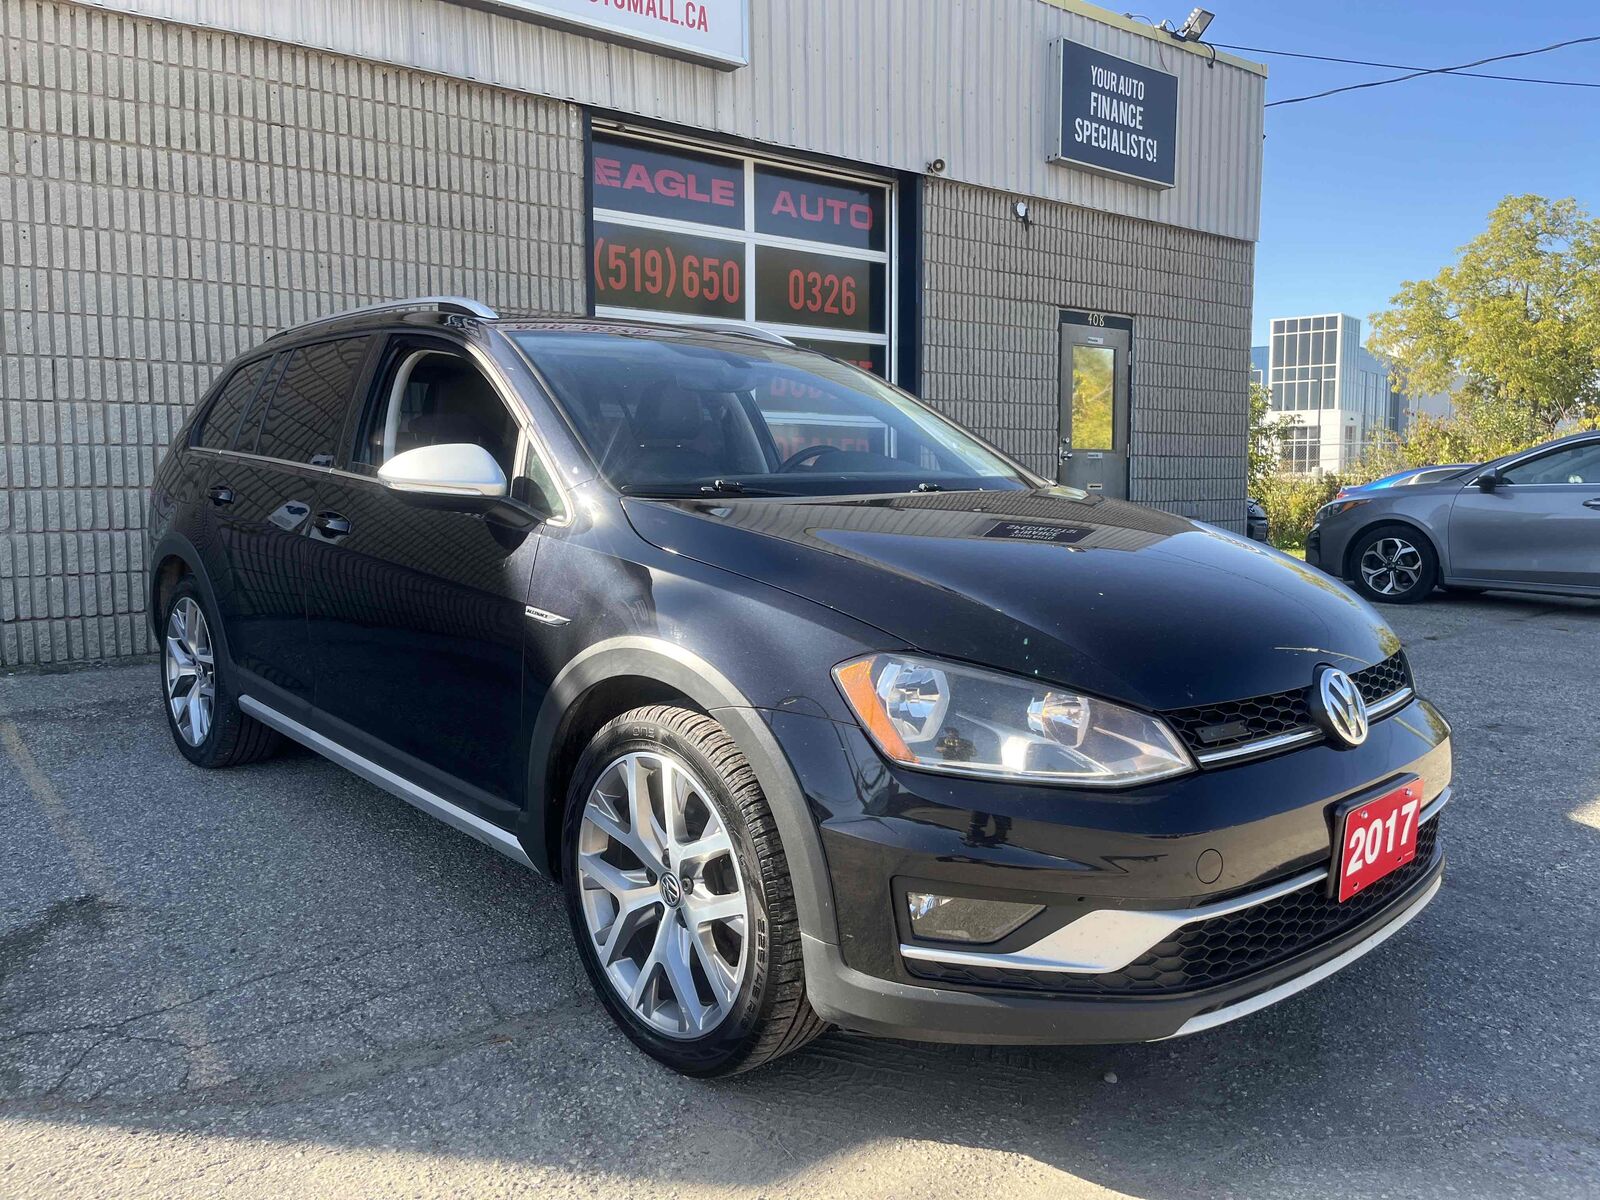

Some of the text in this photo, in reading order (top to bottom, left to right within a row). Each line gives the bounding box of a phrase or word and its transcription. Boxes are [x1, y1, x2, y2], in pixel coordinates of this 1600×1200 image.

[589, 0, 708, 32] MALL.CA
[1090, 65, 1145, 101] YOUR AUTO
[1090, 92, 1144, 130] FINANCE
[1074, 118, 1158, 163] SPECIALISTS!
[594, 156, 872, 231] EAGLE AUTO
[788, 269, 857, 316] 0326
[1088, 313, 1105, 327] 408
[1346, 799, 1418, 877] 2017
